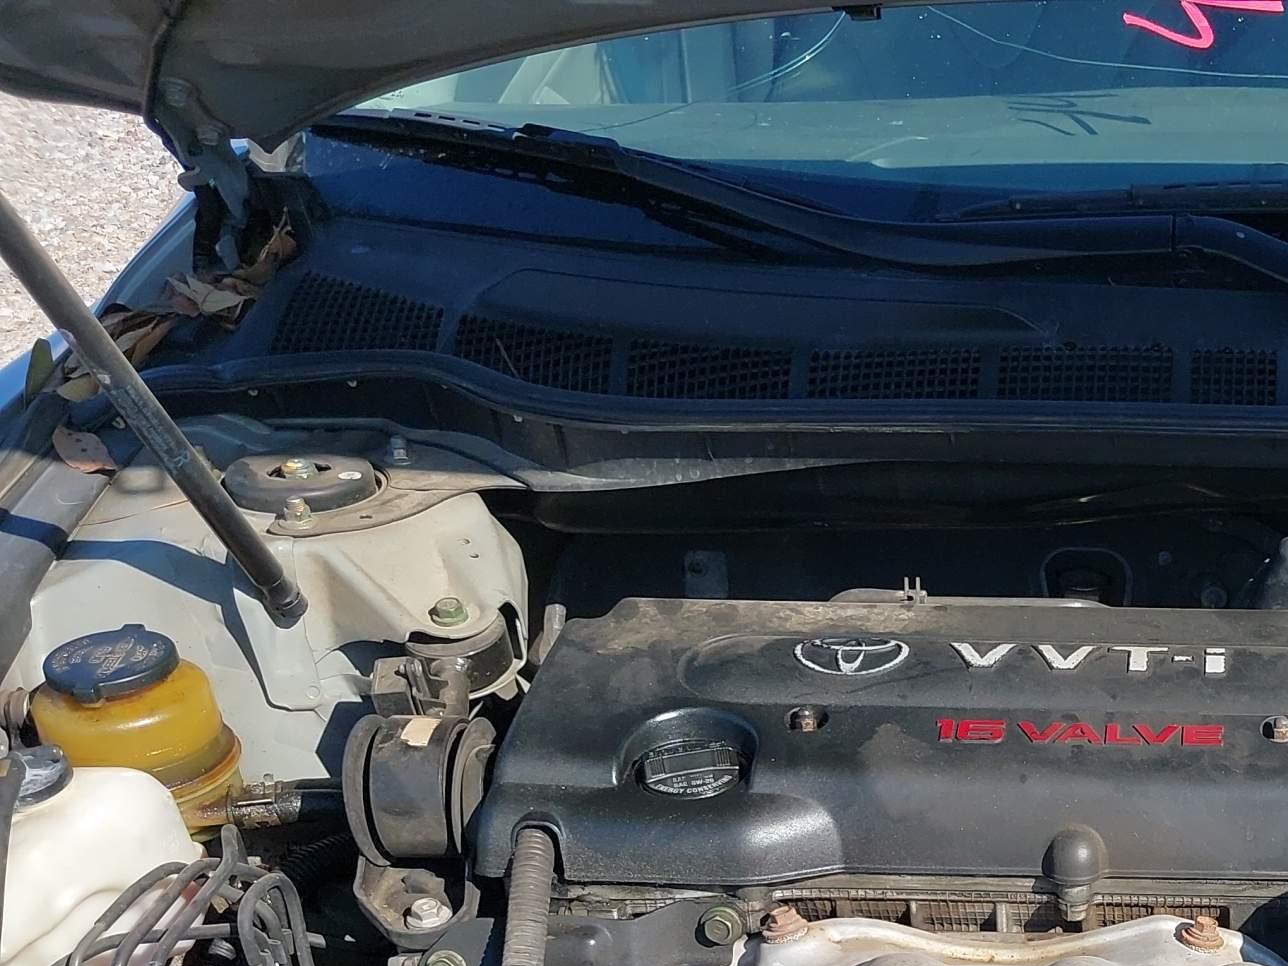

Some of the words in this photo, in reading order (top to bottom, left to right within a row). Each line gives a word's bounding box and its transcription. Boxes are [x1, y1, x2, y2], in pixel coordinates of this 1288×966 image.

[951, 643, 1226, 674] VVT-i
[937, 719, 1005, 741] 16
[1018, 721, 1223, 746] VALVE
